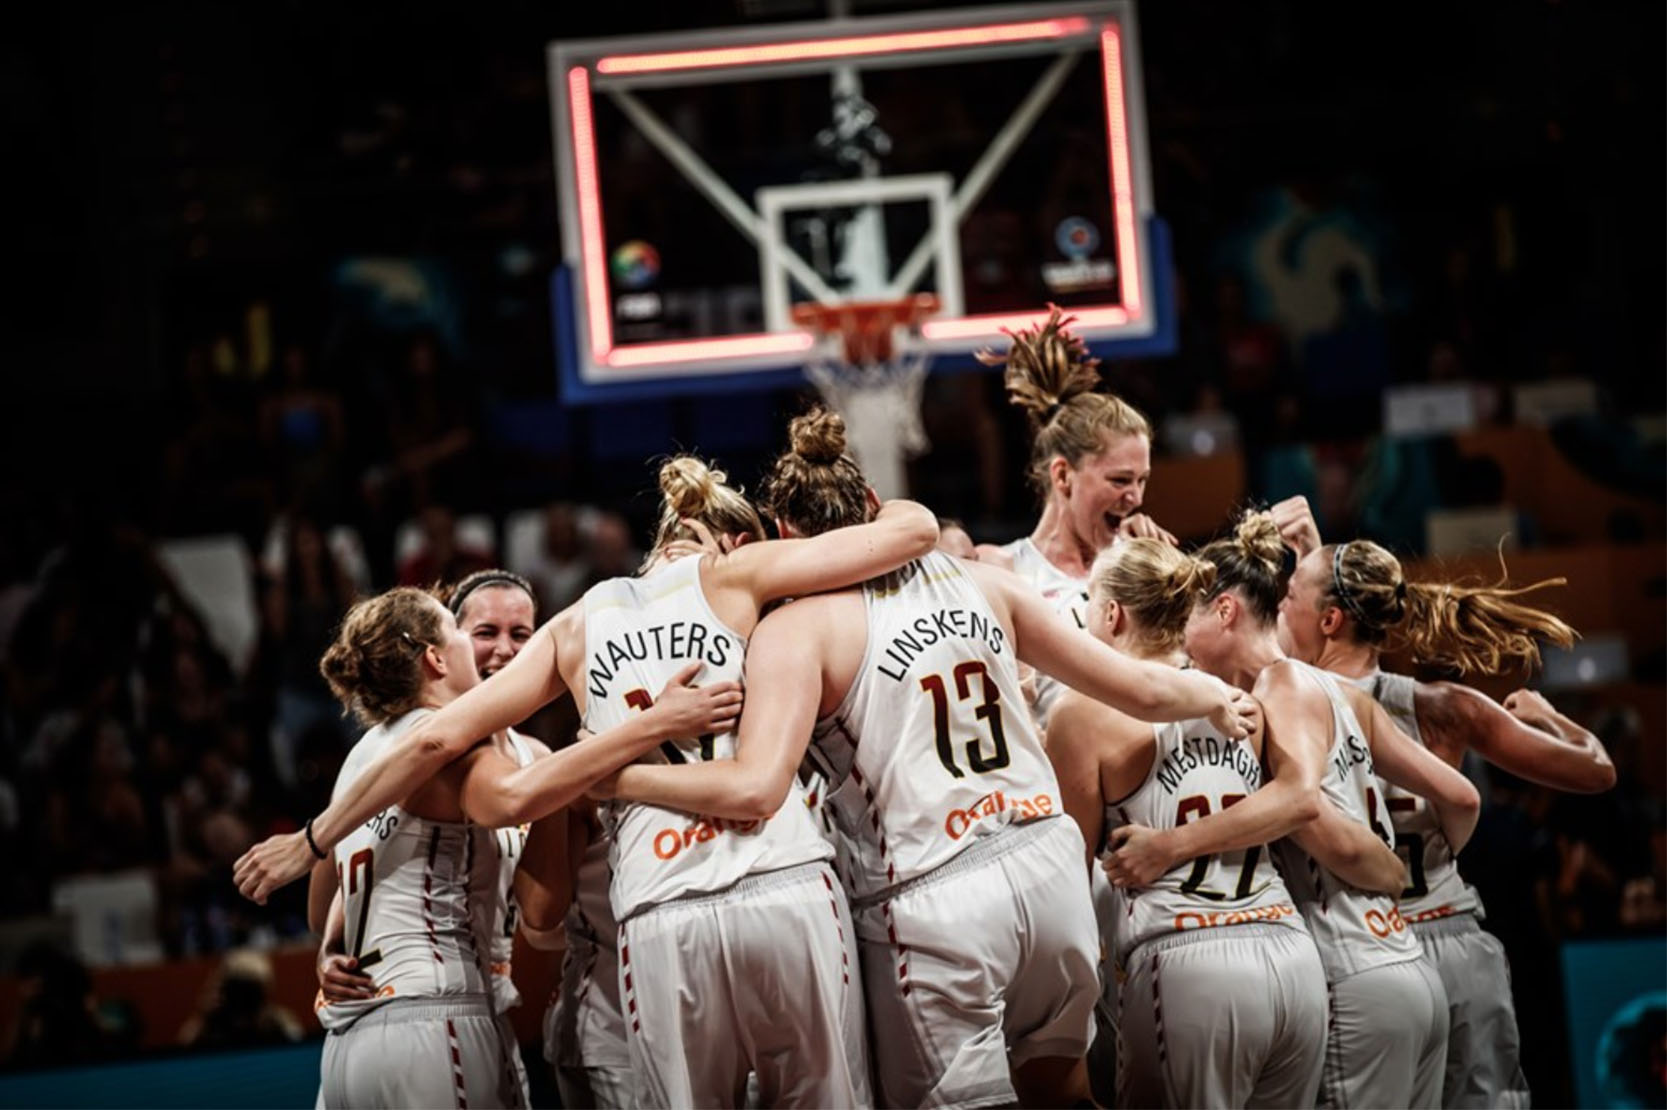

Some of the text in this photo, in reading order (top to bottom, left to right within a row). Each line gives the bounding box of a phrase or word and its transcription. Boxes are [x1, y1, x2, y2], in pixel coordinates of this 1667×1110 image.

[589, 622, 731, 699] WAUTERS
[877, 609, 1003, 682] LINSKENS
[920, 660, 1011, 779] 13
